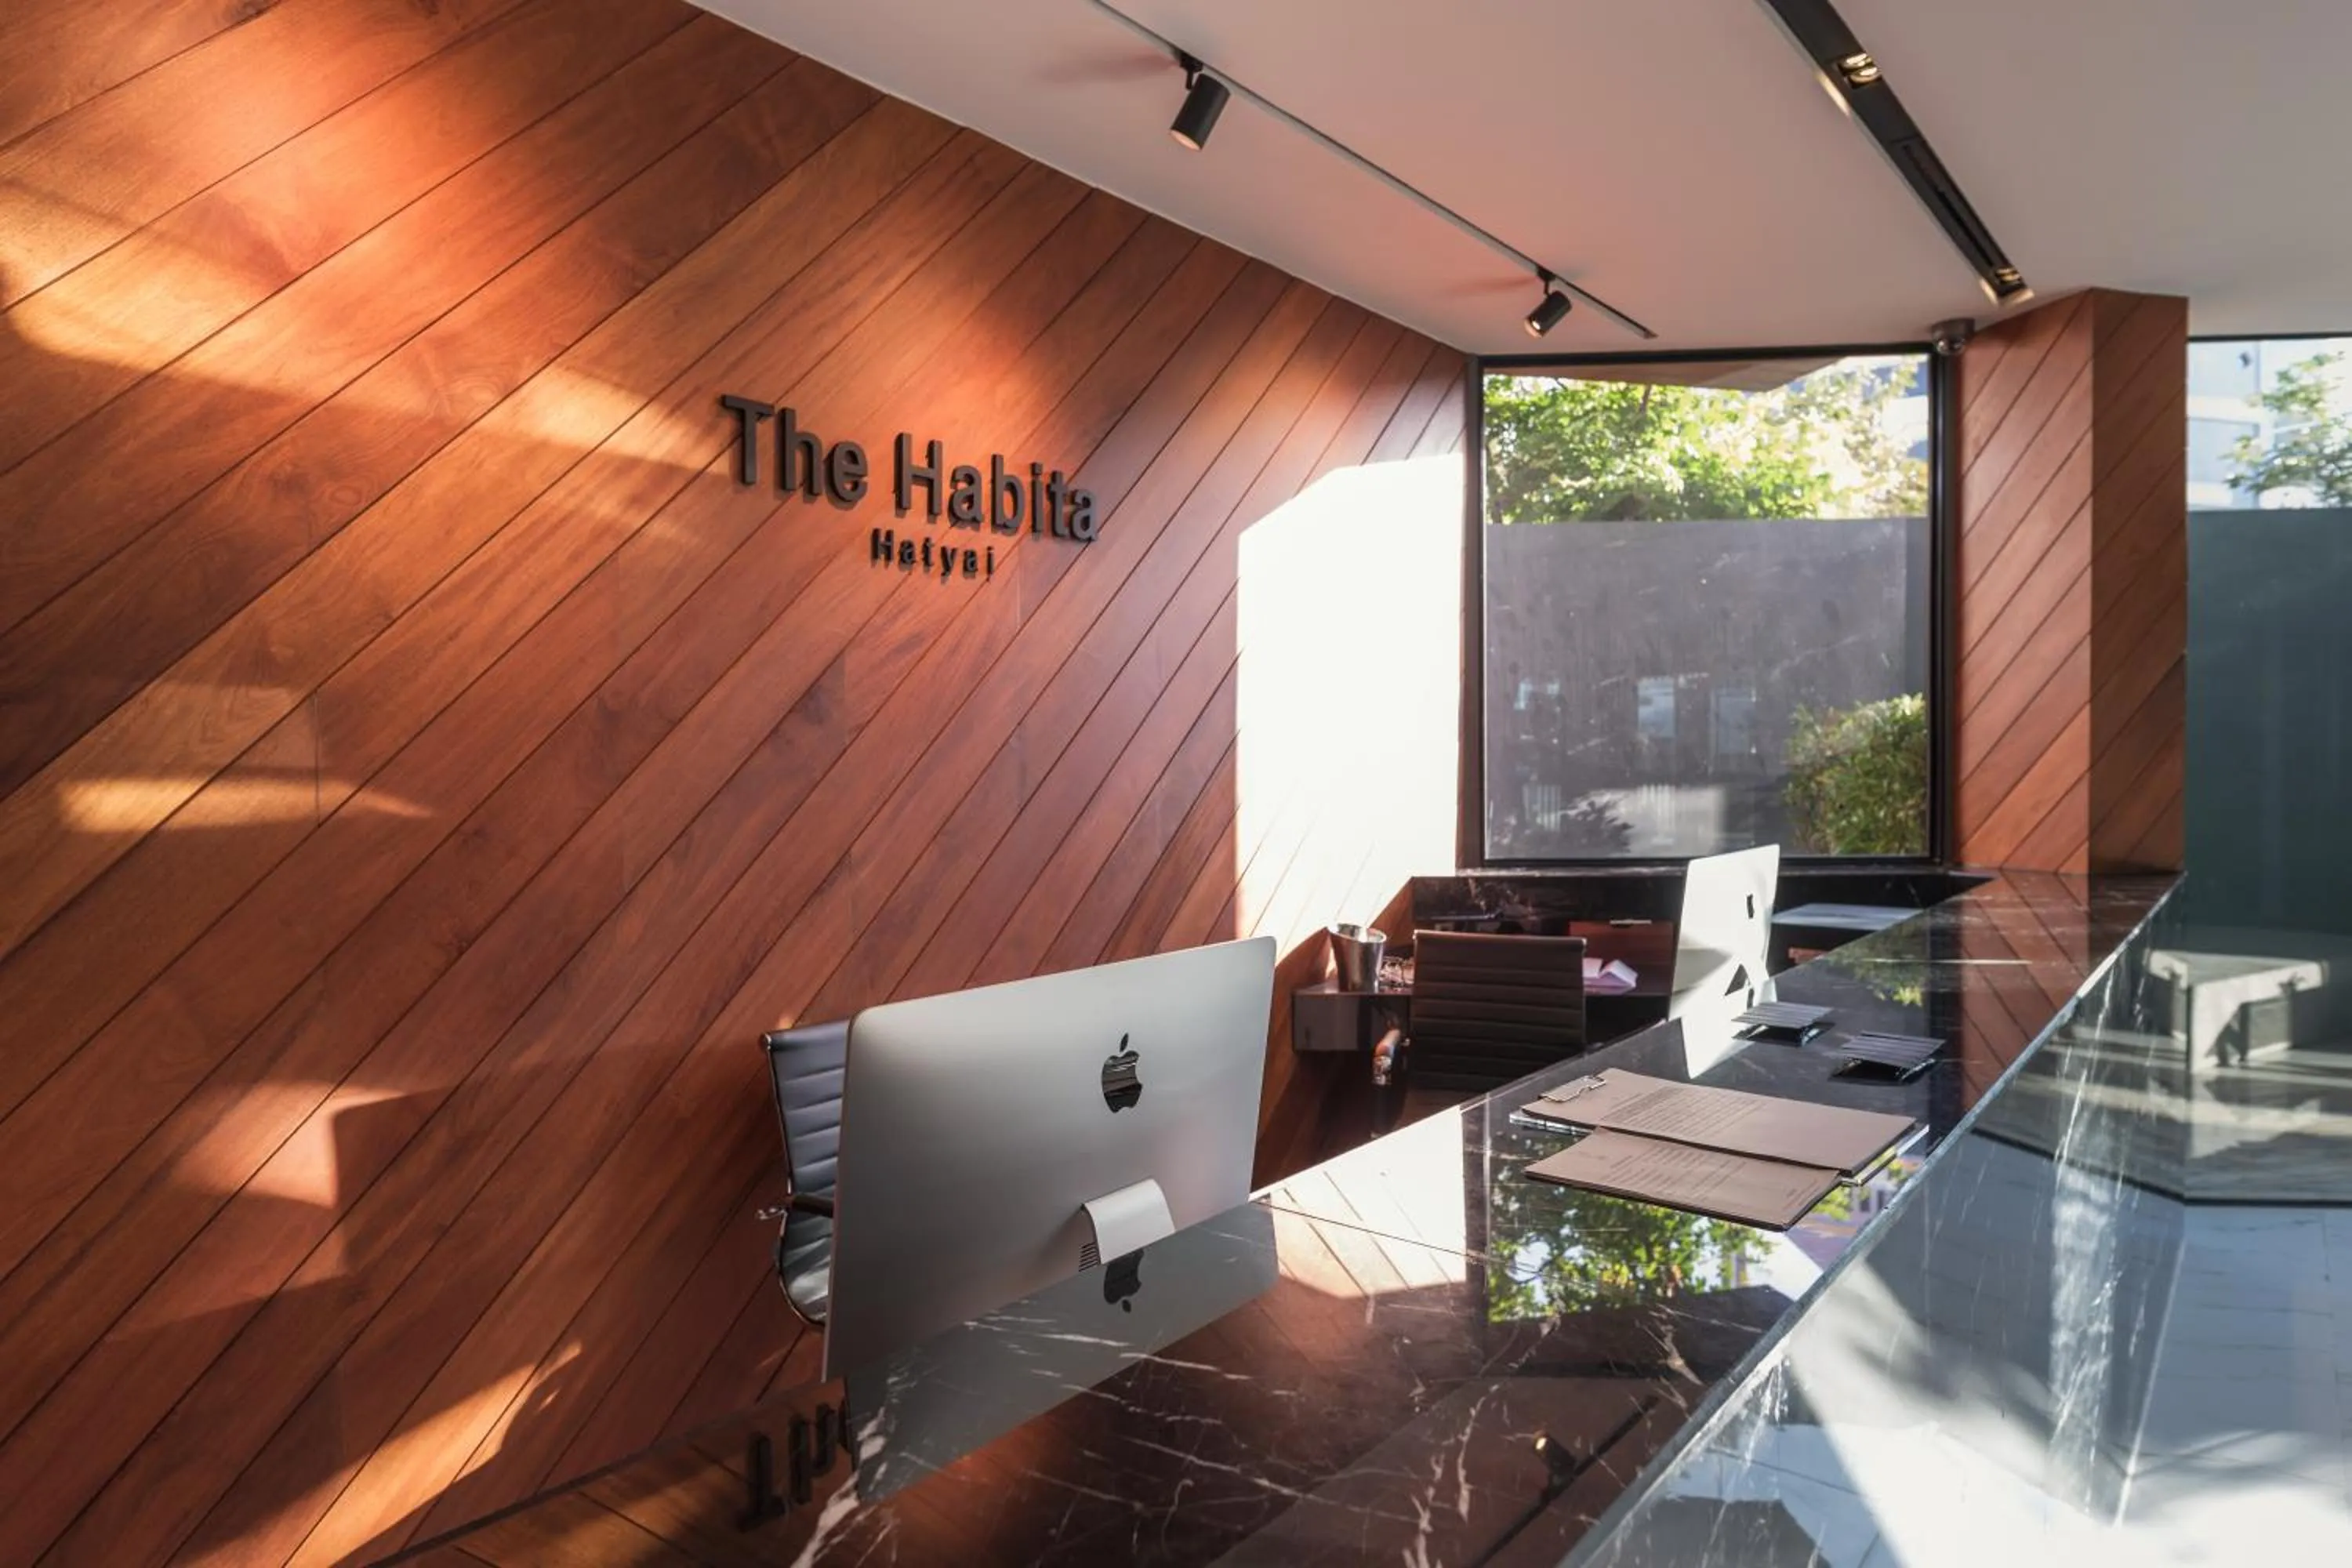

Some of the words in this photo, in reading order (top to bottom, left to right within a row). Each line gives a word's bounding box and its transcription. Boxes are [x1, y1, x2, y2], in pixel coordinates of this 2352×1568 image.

[721, 394, 868, 503] The
[894, 433, 1096, 542] Habita
[871, 528, 995, 576] Hatyai
